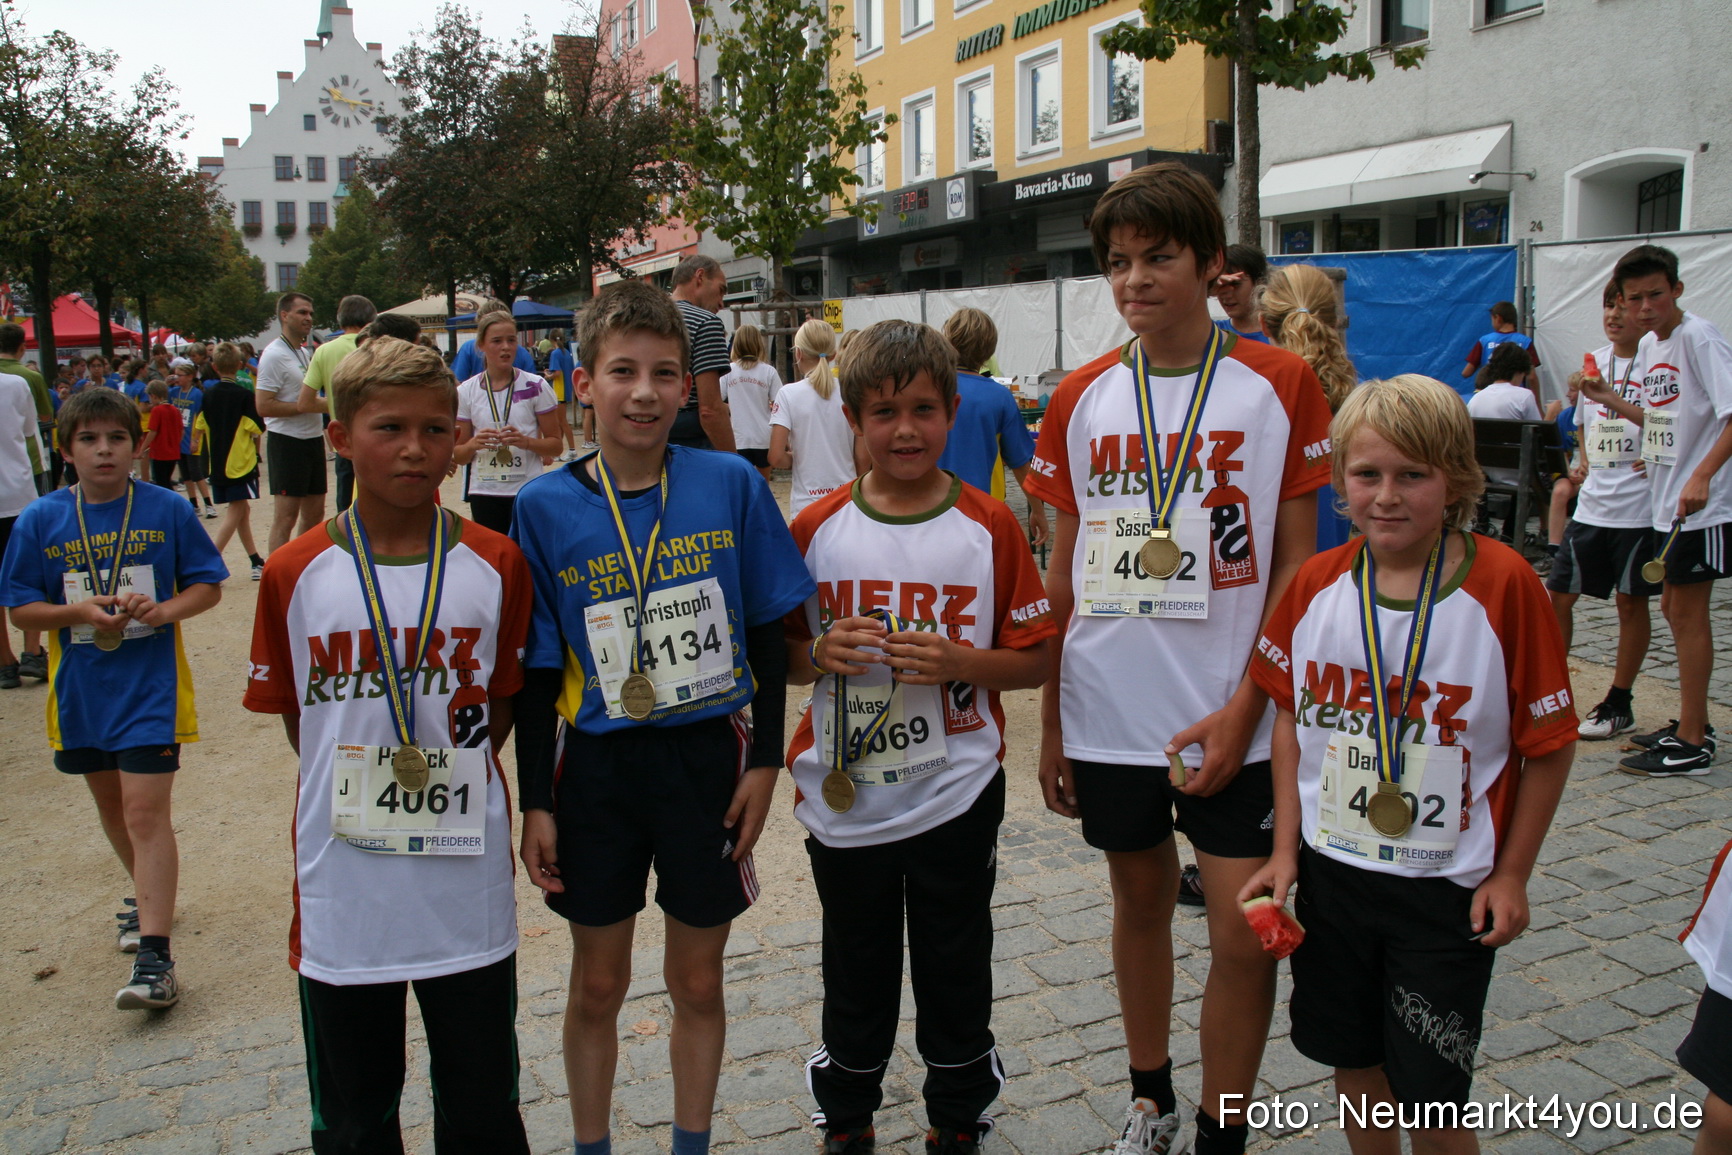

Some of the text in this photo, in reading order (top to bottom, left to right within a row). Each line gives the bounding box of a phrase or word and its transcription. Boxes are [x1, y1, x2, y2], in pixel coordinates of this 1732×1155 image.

[955, 24, 1005, 63] RITTER
[1015, 172, 1093, 200] Bavaria-Kino
[950, 192, 963, 205] RDM
[1530, 220, 1544, 232] 24
[824, 302, 842, 319] Chip-
[1598, 424, 1624, 433] Thomas
[1598, 438, 1634, 452] 4112
[1648, 430, 1674, 447] 4113
[1090, 430, 1244, 475] MERZ
[490, 456, 522, 468] 433
[44, 546, 64, 559] 10.
[1088, 550, 1095, 565] J
[557, 566, 585, 587] 10.
[1217, 567, 1252, 581] MERZ
[817, 580, 977, 626] MERZ
[1092, 603, 1121, 611] BOCK
[1154, 601, 1205, 611] PFLEIDERER
[642, 623, 721, 671] 4134
[601, 648, 609, 664] J
[691, 671, 733, 692] PFLEIDERER
[1303, 659, 1473, 731] MERZ
[846, 695, 884, 714] ukas
[825, 720, 830, 735] J
[850, 716, 929, 754] 4069
[898, 757, 947, 777] PFLEIDERER
[339, 778, 349, 795] J
[1322, 776, 1329, 792] J
[376, 782, 470, 815] 4061
[346, 838, 386, 847] BOCK
[425, 836, 481, 847] PFLEIDERER
[1327, 835, 1358, 851] BOCK
[1395, 846, 1453, 861] PFLEIDERER
